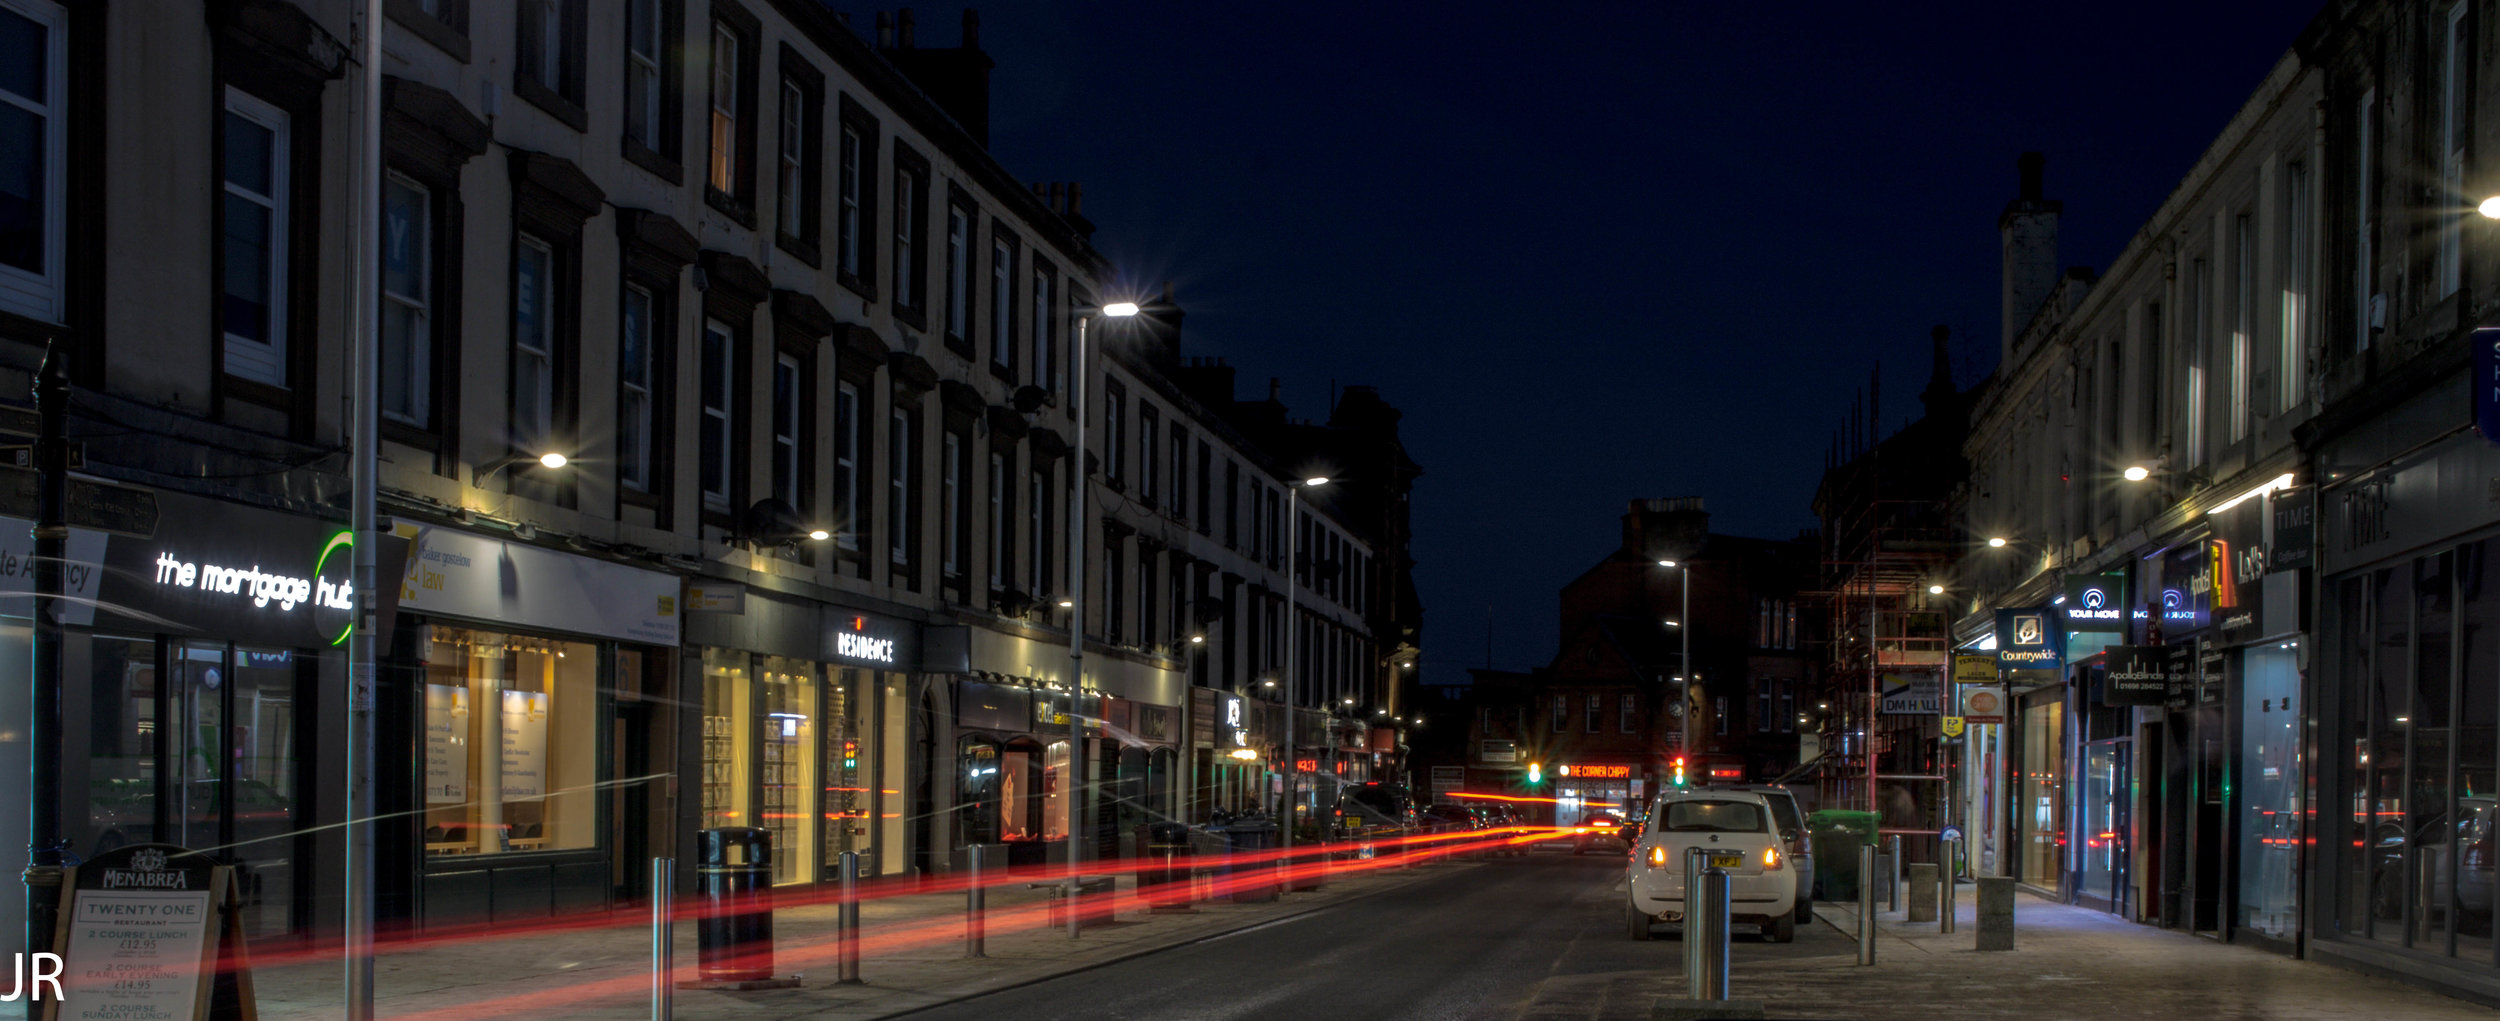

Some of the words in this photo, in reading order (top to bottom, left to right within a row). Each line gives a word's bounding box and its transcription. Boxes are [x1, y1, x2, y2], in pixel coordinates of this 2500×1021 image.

[2276, 505, 2311, 530] TIME
[156, 552, 197, 588] the
[201, 565, 311, 611] mortgage
[422, 563, 445, 591] law
[2068, 609, 2093, 619] YOUR
[2094, 609, 2120, 619] MOVE
[838, 632, 893, 663] RESIDENCE
[2001, 649, 2057, 663] Countrywide
[1886, 699, 1906, 711] DM
[1908, 699, 1939, 711] HALL
[1570, 765, 1582, 777] THE
[1582, 765, 1607, 778] CORNER
[1607, 765, 1631, 778] CHIPPY
[103, 869, 187, 889] MENABREA
[88, 904, 158, 915] TWENTY
[161, 904, 196, 915] ONE
[88, 930, 96, 938] 2
[99, 930, 146, 939] COURSE
[149, 930, 188, 939] LUNCH
[119, 940, 157, 949] £12.95
[116, 964, 163, 972] COURSE
[86, 971, 128, 979] EARLY
[130, 971, 179, 979] EVENING
[114, 980, 151, 990] £14.95
[100, 1004, 107, 1012] 2
[110, 1004, 157, 1012] COURSE
[81, 1011, 130, 1020] SUNDAY
[133, 1011, 172, 1020] LUNCH
